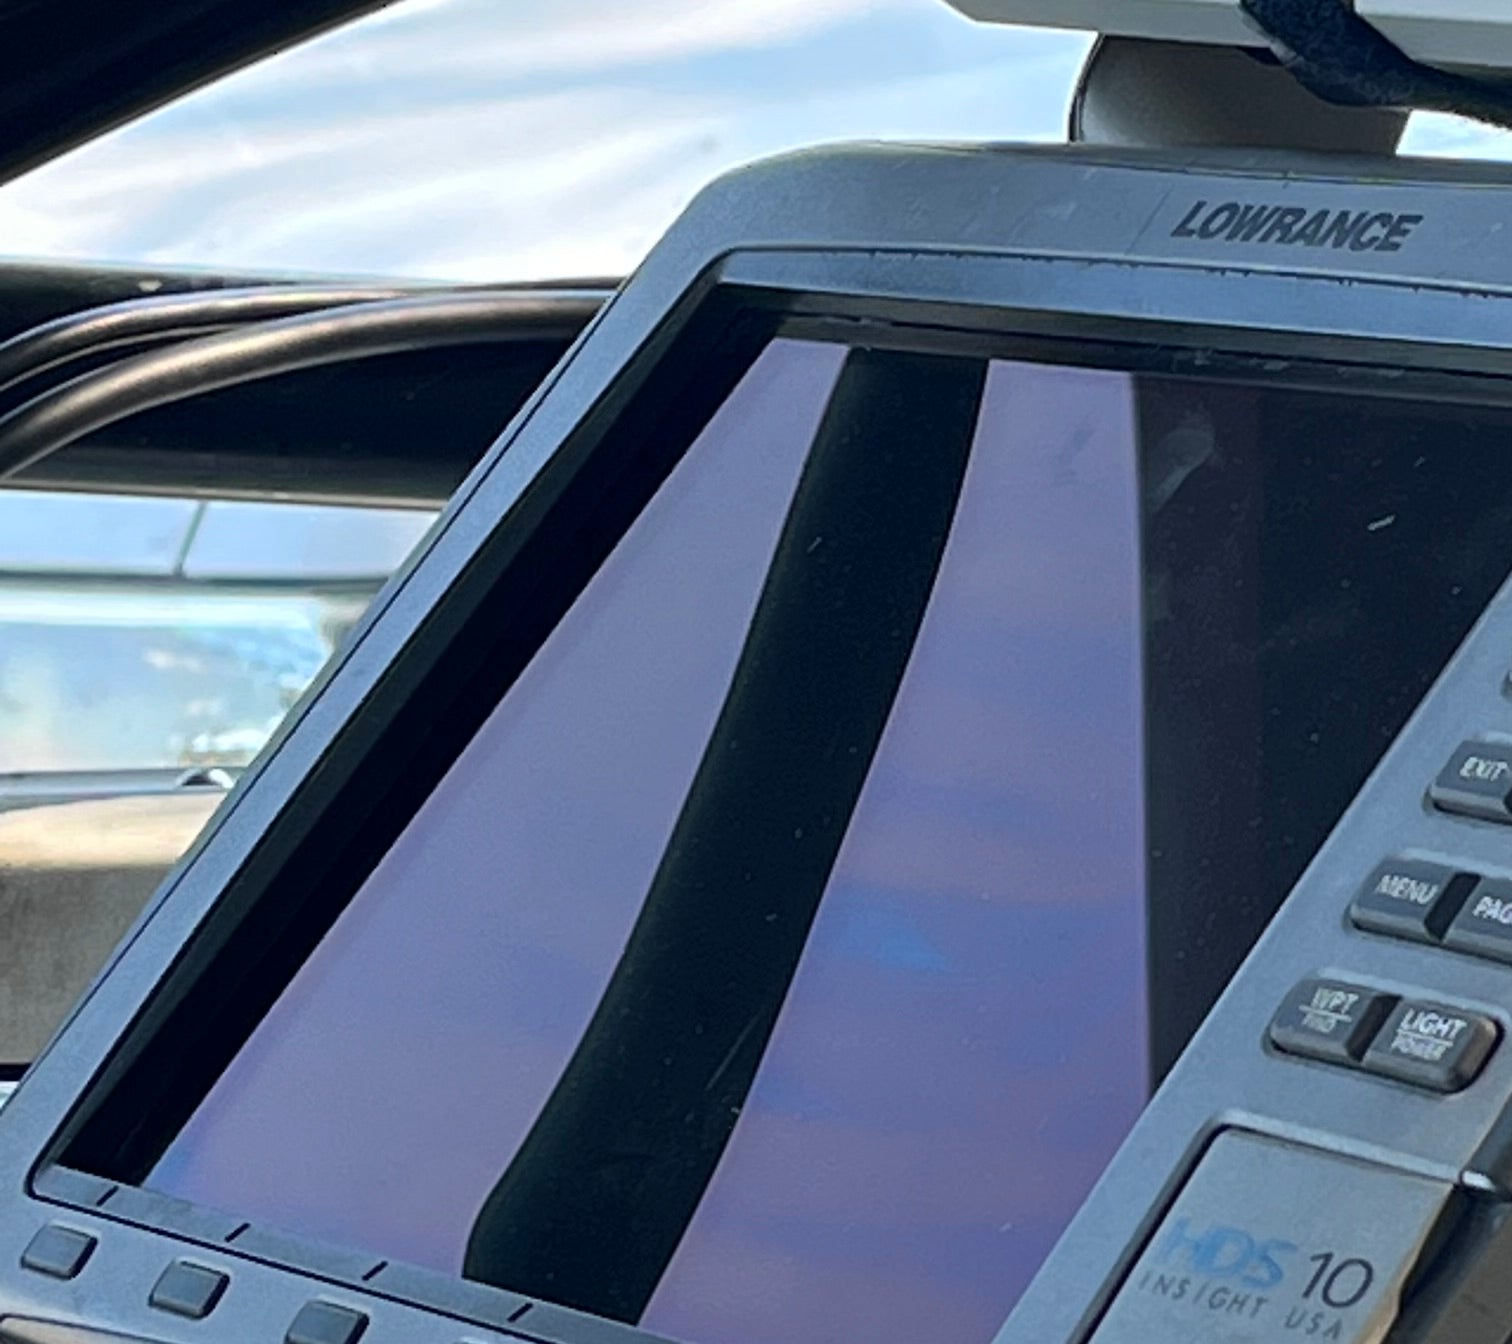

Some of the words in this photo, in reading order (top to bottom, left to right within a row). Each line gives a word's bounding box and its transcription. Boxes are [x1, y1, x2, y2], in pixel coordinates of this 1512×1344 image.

[1170, 200, 1424, 253] LOWRANCE
[1459, 756, 1509, 781] EXIT
[1374, 874, 1438, 906] MENU
[1311, 987, 1360, 1014] WPT
[1400, 1008, 1468, 1040] LIGHT
[1159, 1218, 1299, 1290] HDS
[1301, 1250, 1375, 1309] 10
[1138, 1269, 1268, 1320] INSIGHT
[1283, 1308, 1344, 1341] USA
